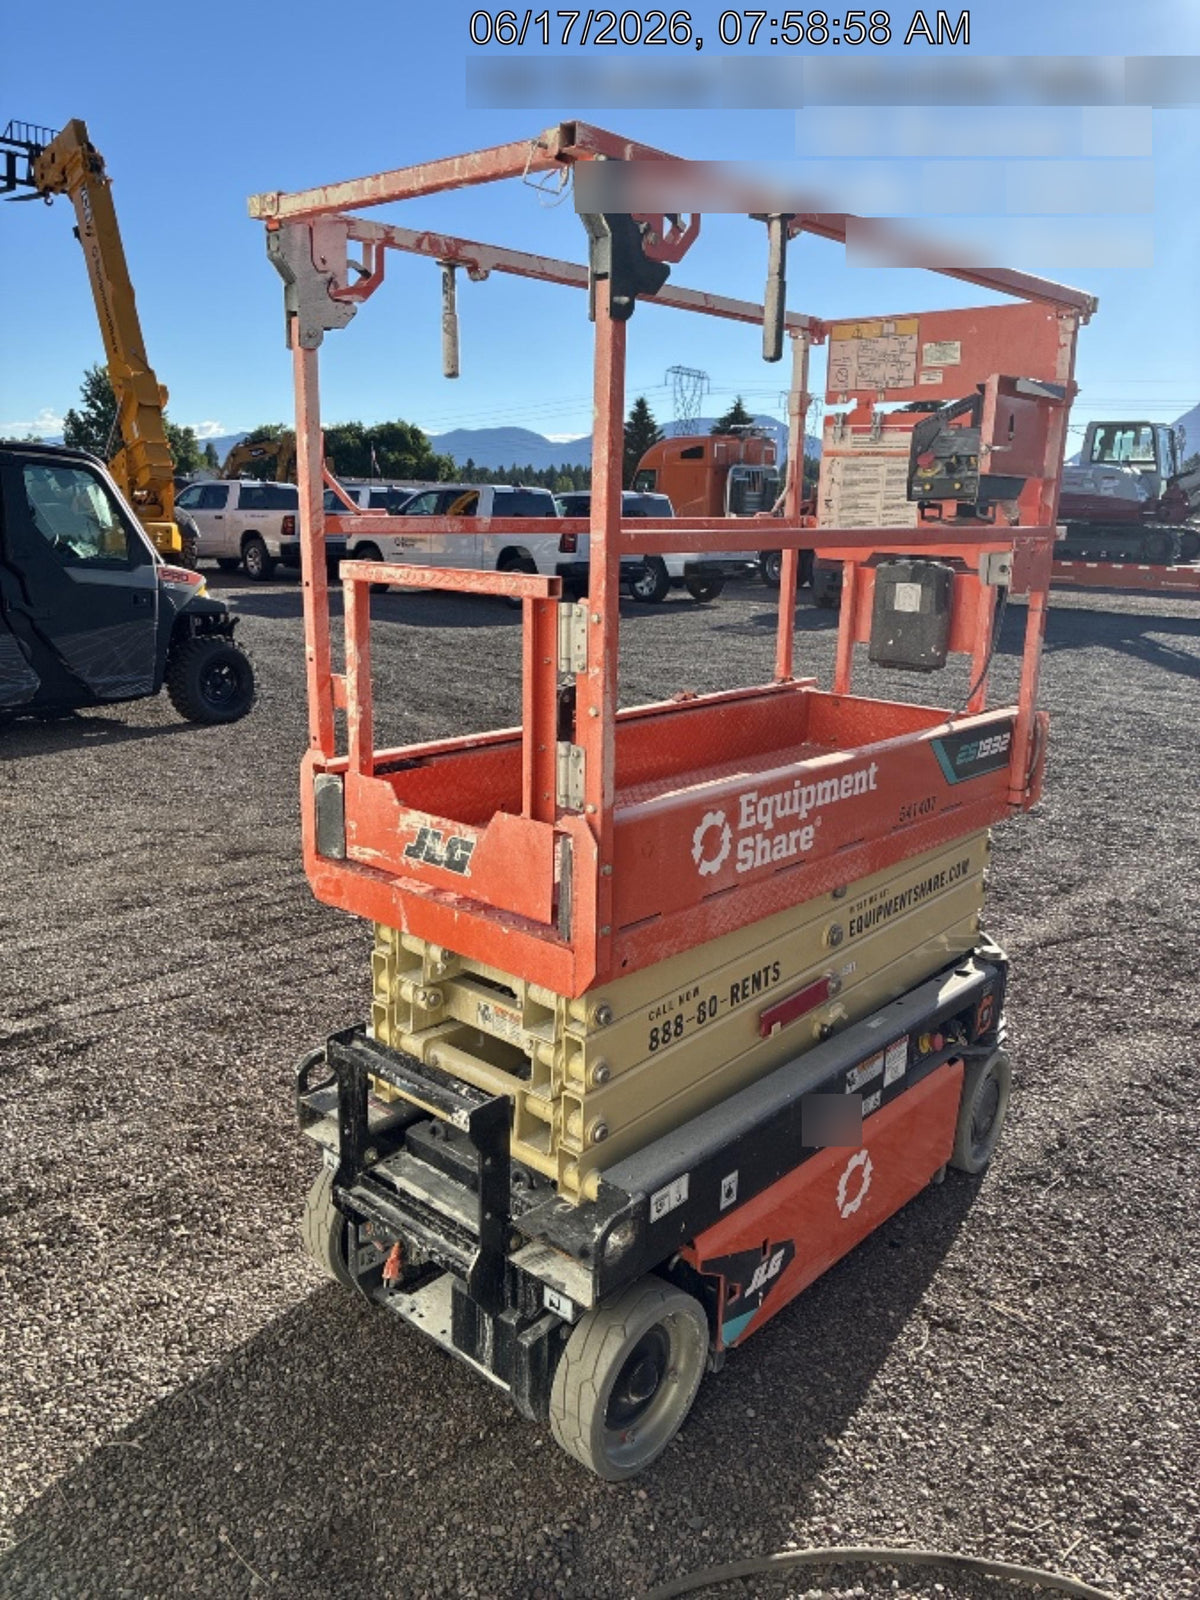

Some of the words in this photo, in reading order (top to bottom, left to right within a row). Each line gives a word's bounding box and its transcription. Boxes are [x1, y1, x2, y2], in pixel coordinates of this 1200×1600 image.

[161, 570, 189, 582] PRO
[738, 762, 878, 830] Equipment
[403, 826, 477, 879] JLG
[736, 824, 815, 873] Share
[849, 858, 970, 937] EQUIPMENTSHARE.COM
[648, 961, 780, 1051] 888-80-RENTS
[648, 1001, 674, 1021] CALL
[744, 1247, 785, 1298] JLG
